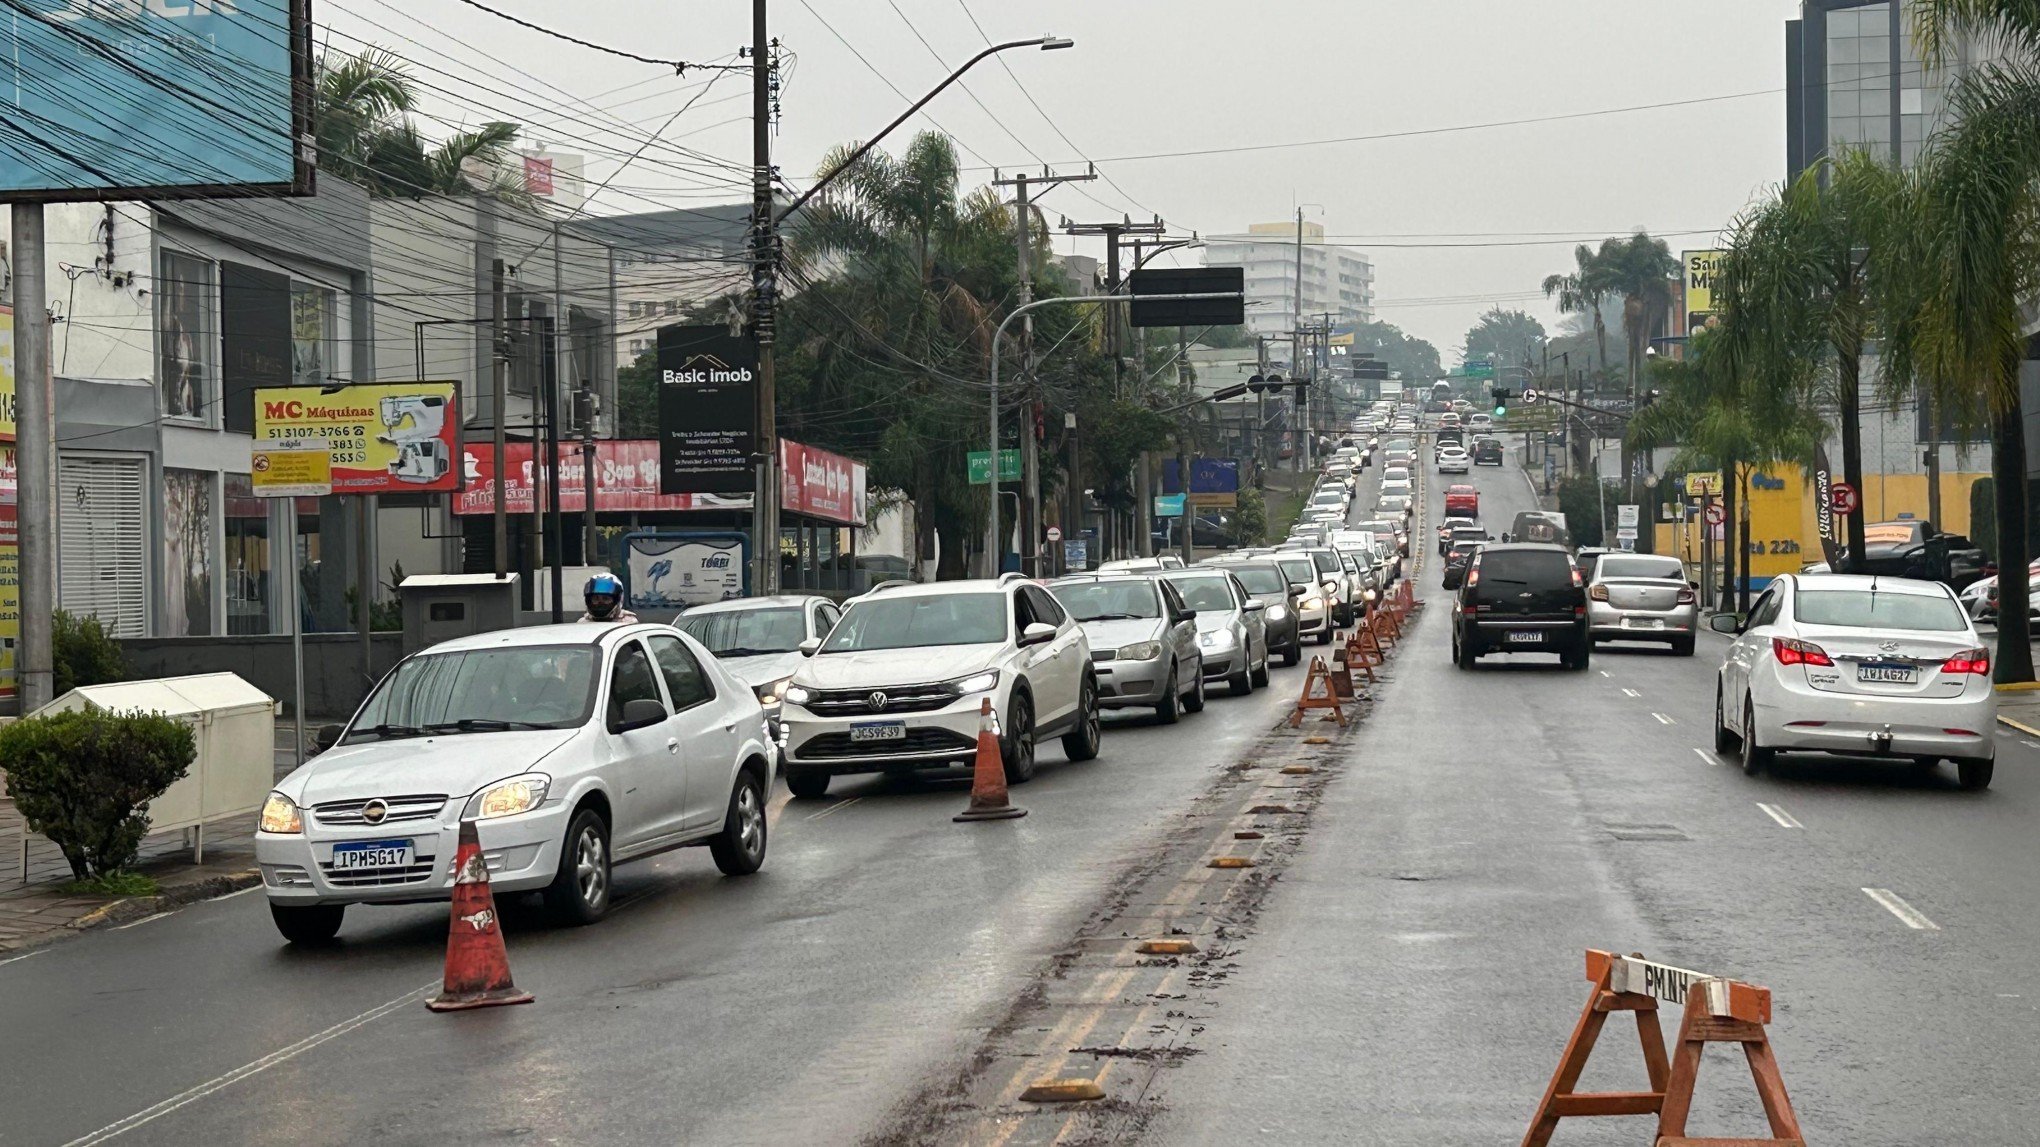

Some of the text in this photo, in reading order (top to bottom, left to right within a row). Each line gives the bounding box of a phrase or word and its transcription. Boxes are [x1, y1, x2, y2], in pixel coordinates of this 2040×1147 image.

[663, 367, 752, 384] Basic imob
[264, 401, 375, 420] MC Máquinas
[269, 426, 350, 438] 51 3107-3766
